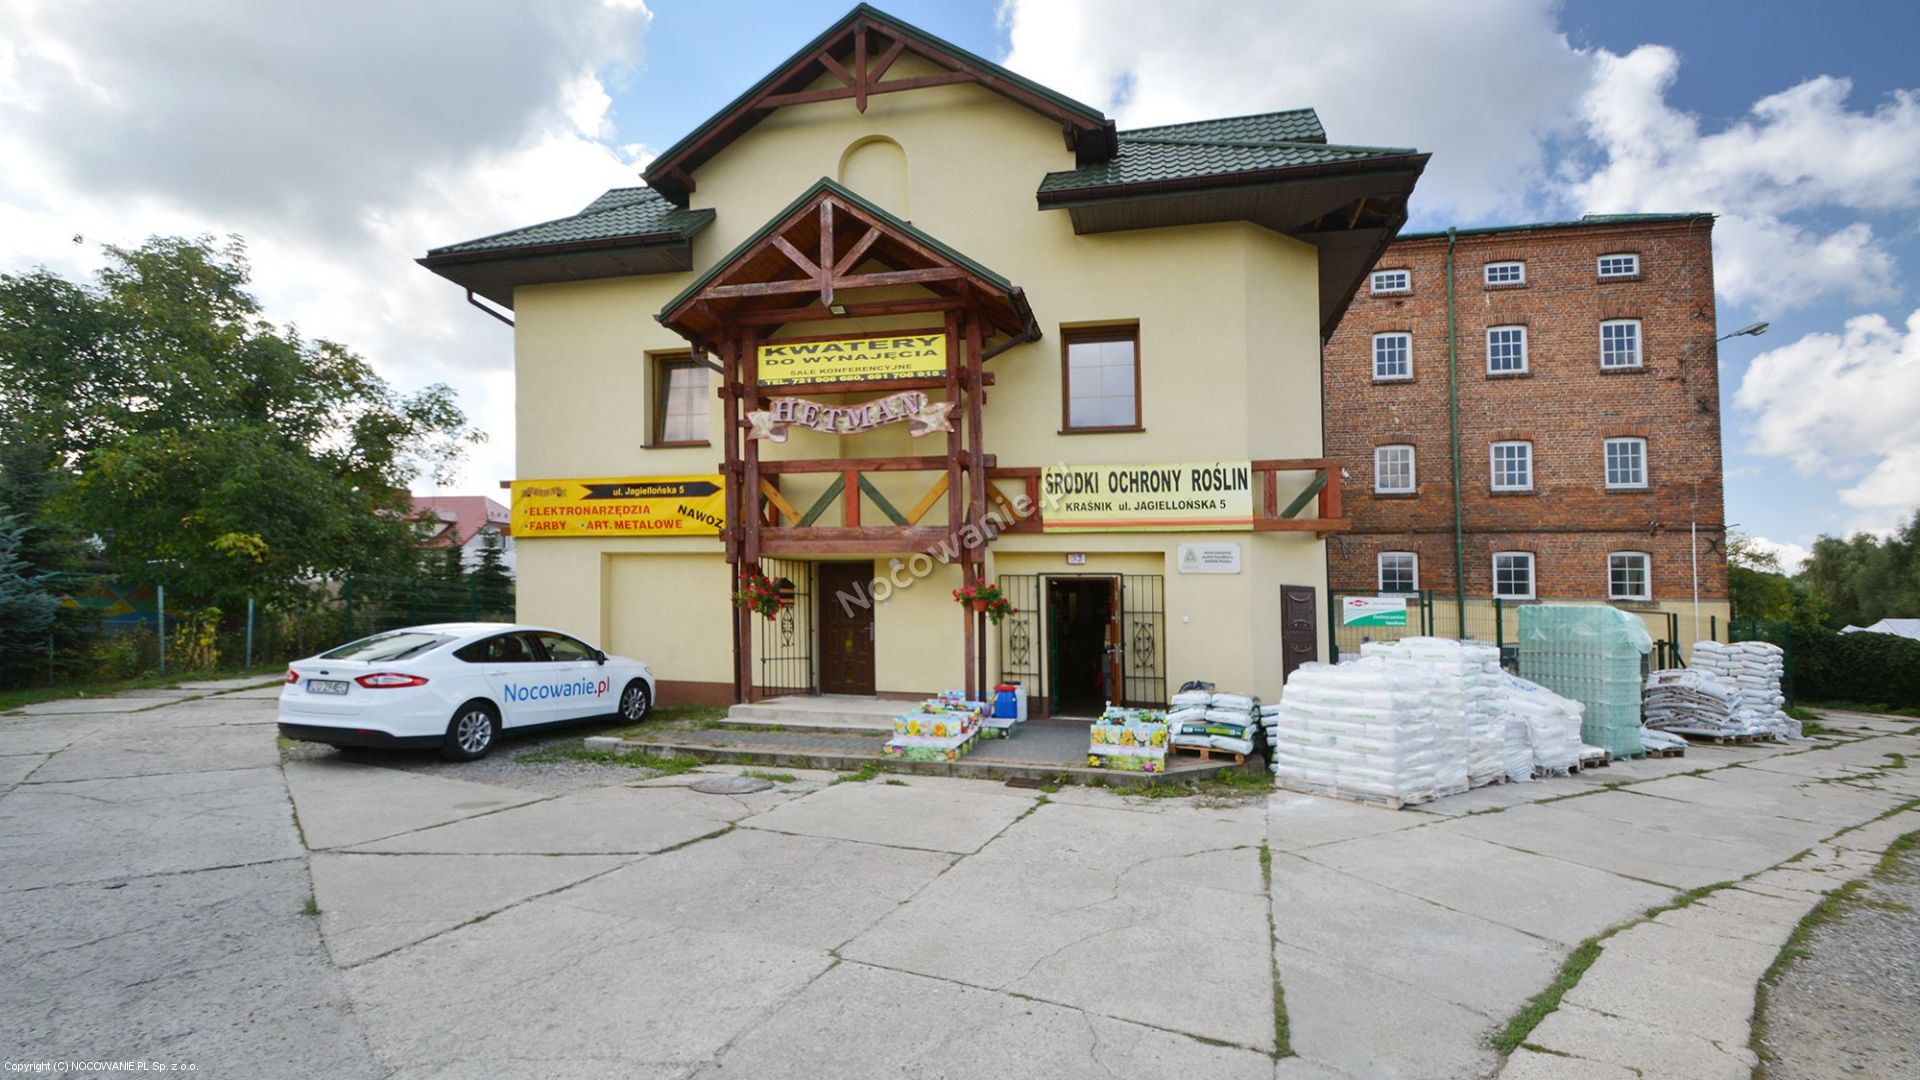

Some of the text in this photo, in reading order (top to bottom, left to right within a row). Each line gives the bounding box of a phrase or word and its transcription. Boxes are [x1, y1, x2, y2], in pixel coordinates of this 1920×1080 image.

[764, 336, 940, 357] KWATERY
[765, 349, 938, 366] DO WYNAJĘCIA
[820, 364, 912, 375] KONFERENCYJNE
[765, 378, 789, 386] TEL.
[774, 393, 921, 431] HETMAN
[1045, 463, 1248, 494] ŚRODKI OCHRONY ROŚLIN
[612, 486, 685, 497] ul. Jagiellońska 5
[529, 505, 651, 517] ELEKTRONARZĘDZIA
[1066, 498, 1226, 512] KRAŚNIK ul. JAGIELLOŃSKA 5
[529, 519, 683, 531] FARBY ART. METALOWE
[504, 676, 610, 702] Nocowanie.pl
